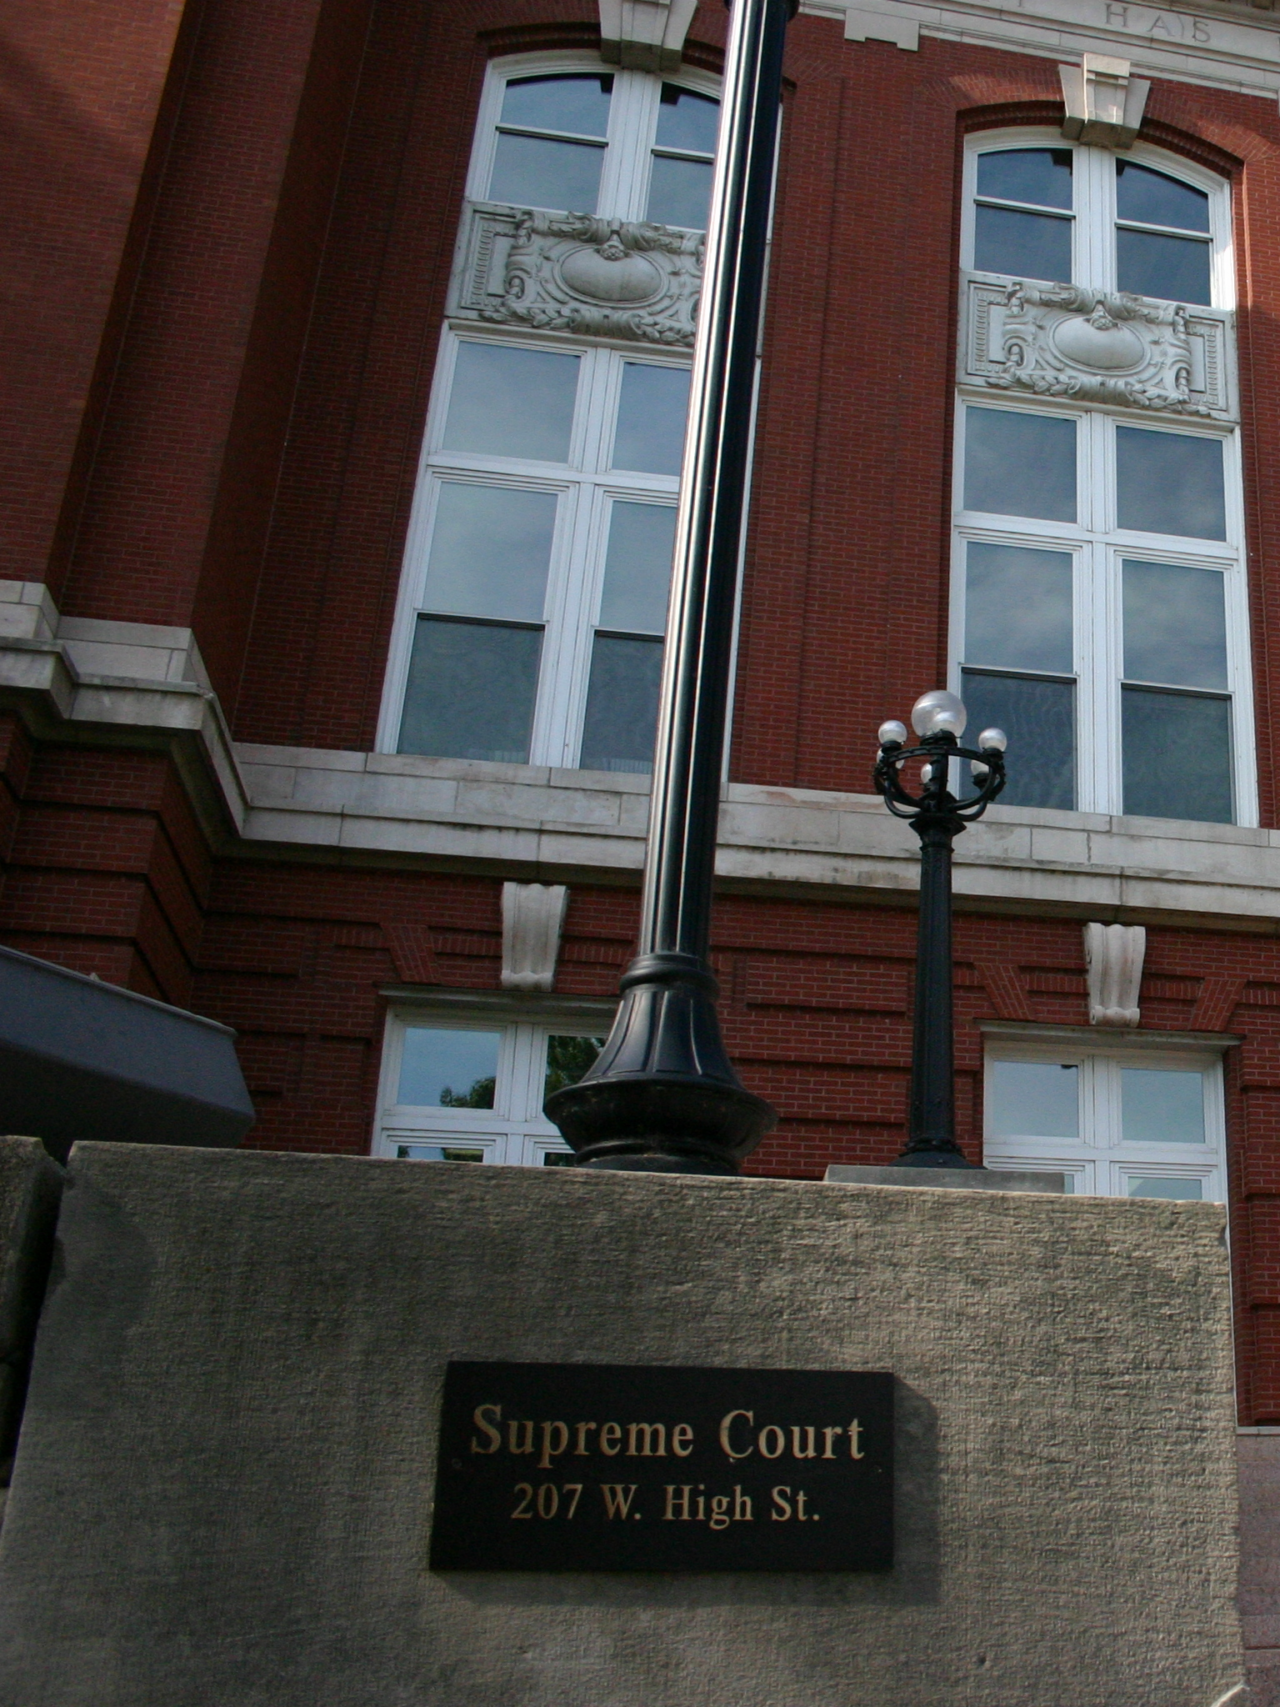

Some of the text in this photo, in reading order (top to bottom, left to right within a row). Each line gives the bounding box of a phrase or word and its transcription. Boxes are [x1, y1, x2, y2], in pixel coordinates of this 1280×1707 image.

[1103, 2, 1211, 43] HAS
[471, 1403, 866, 1469] Supreme Court
[510, 1483, 821, 1531] 207 W. High St.
